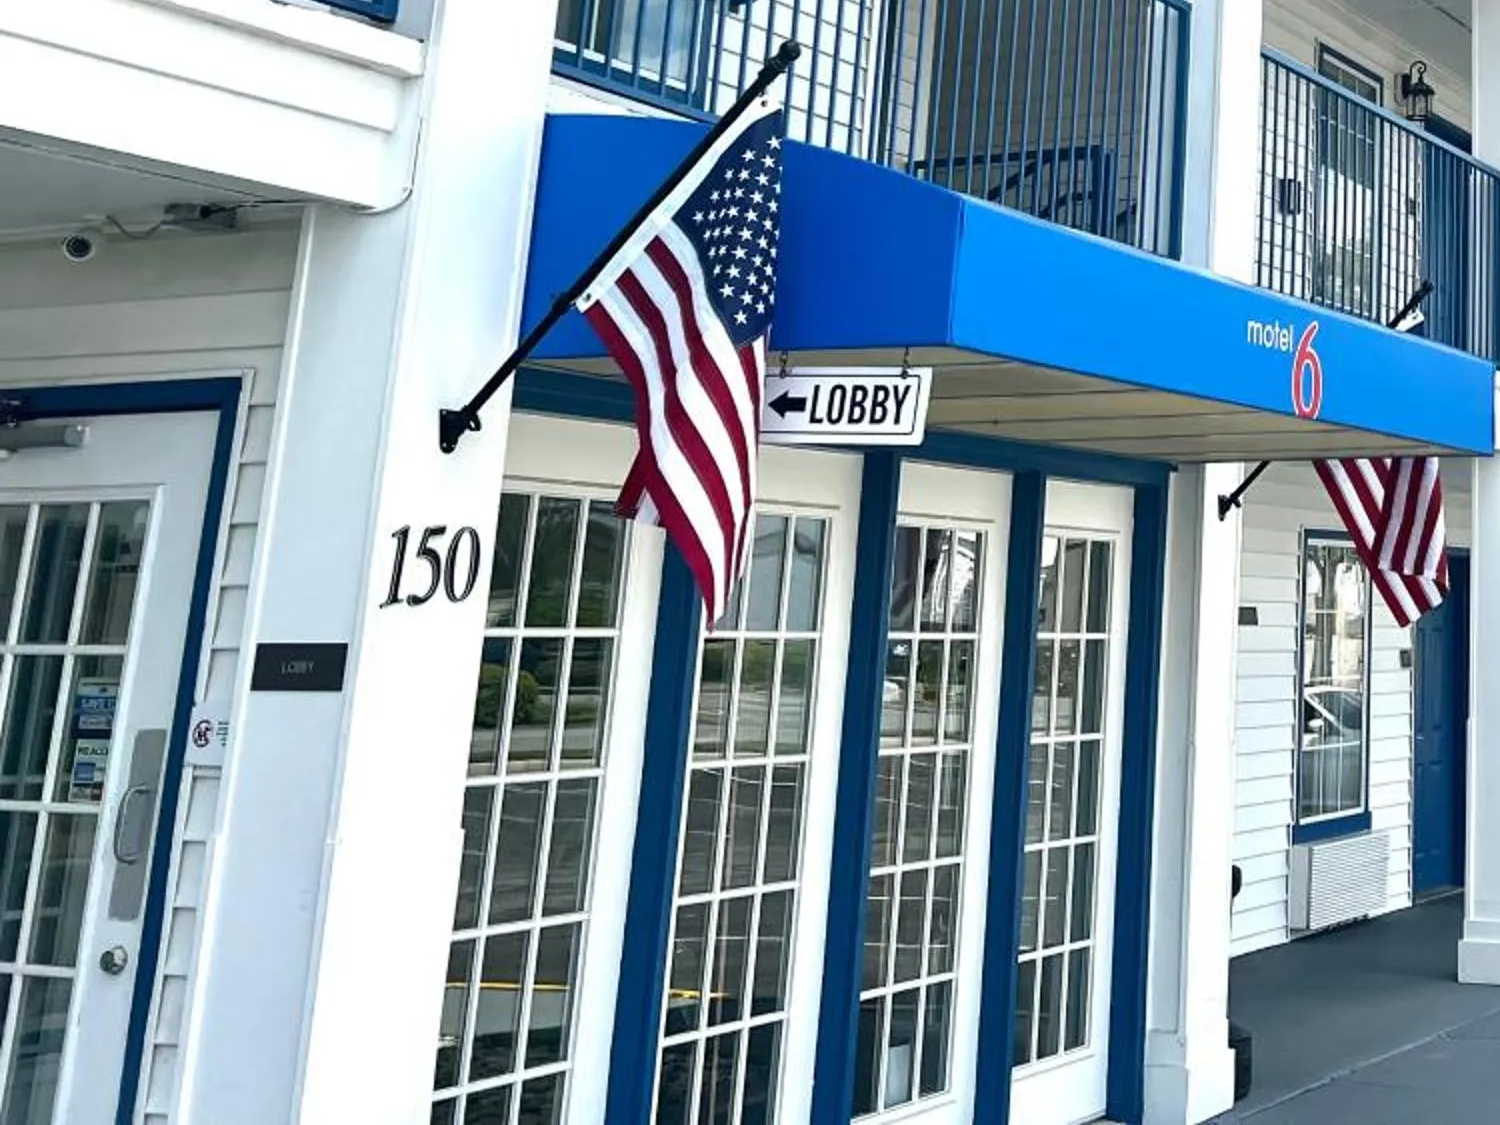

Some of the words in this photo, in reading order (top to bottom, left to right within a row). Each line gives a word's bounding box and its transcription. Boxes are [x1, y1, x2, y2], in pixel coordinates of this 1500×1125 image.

[809, 384, 912, 425] LOBBY
[1247, 320, 1294, 353] motel
[1292, 321, 1323, 420] 6
[379, 524, 481, 609] 150
